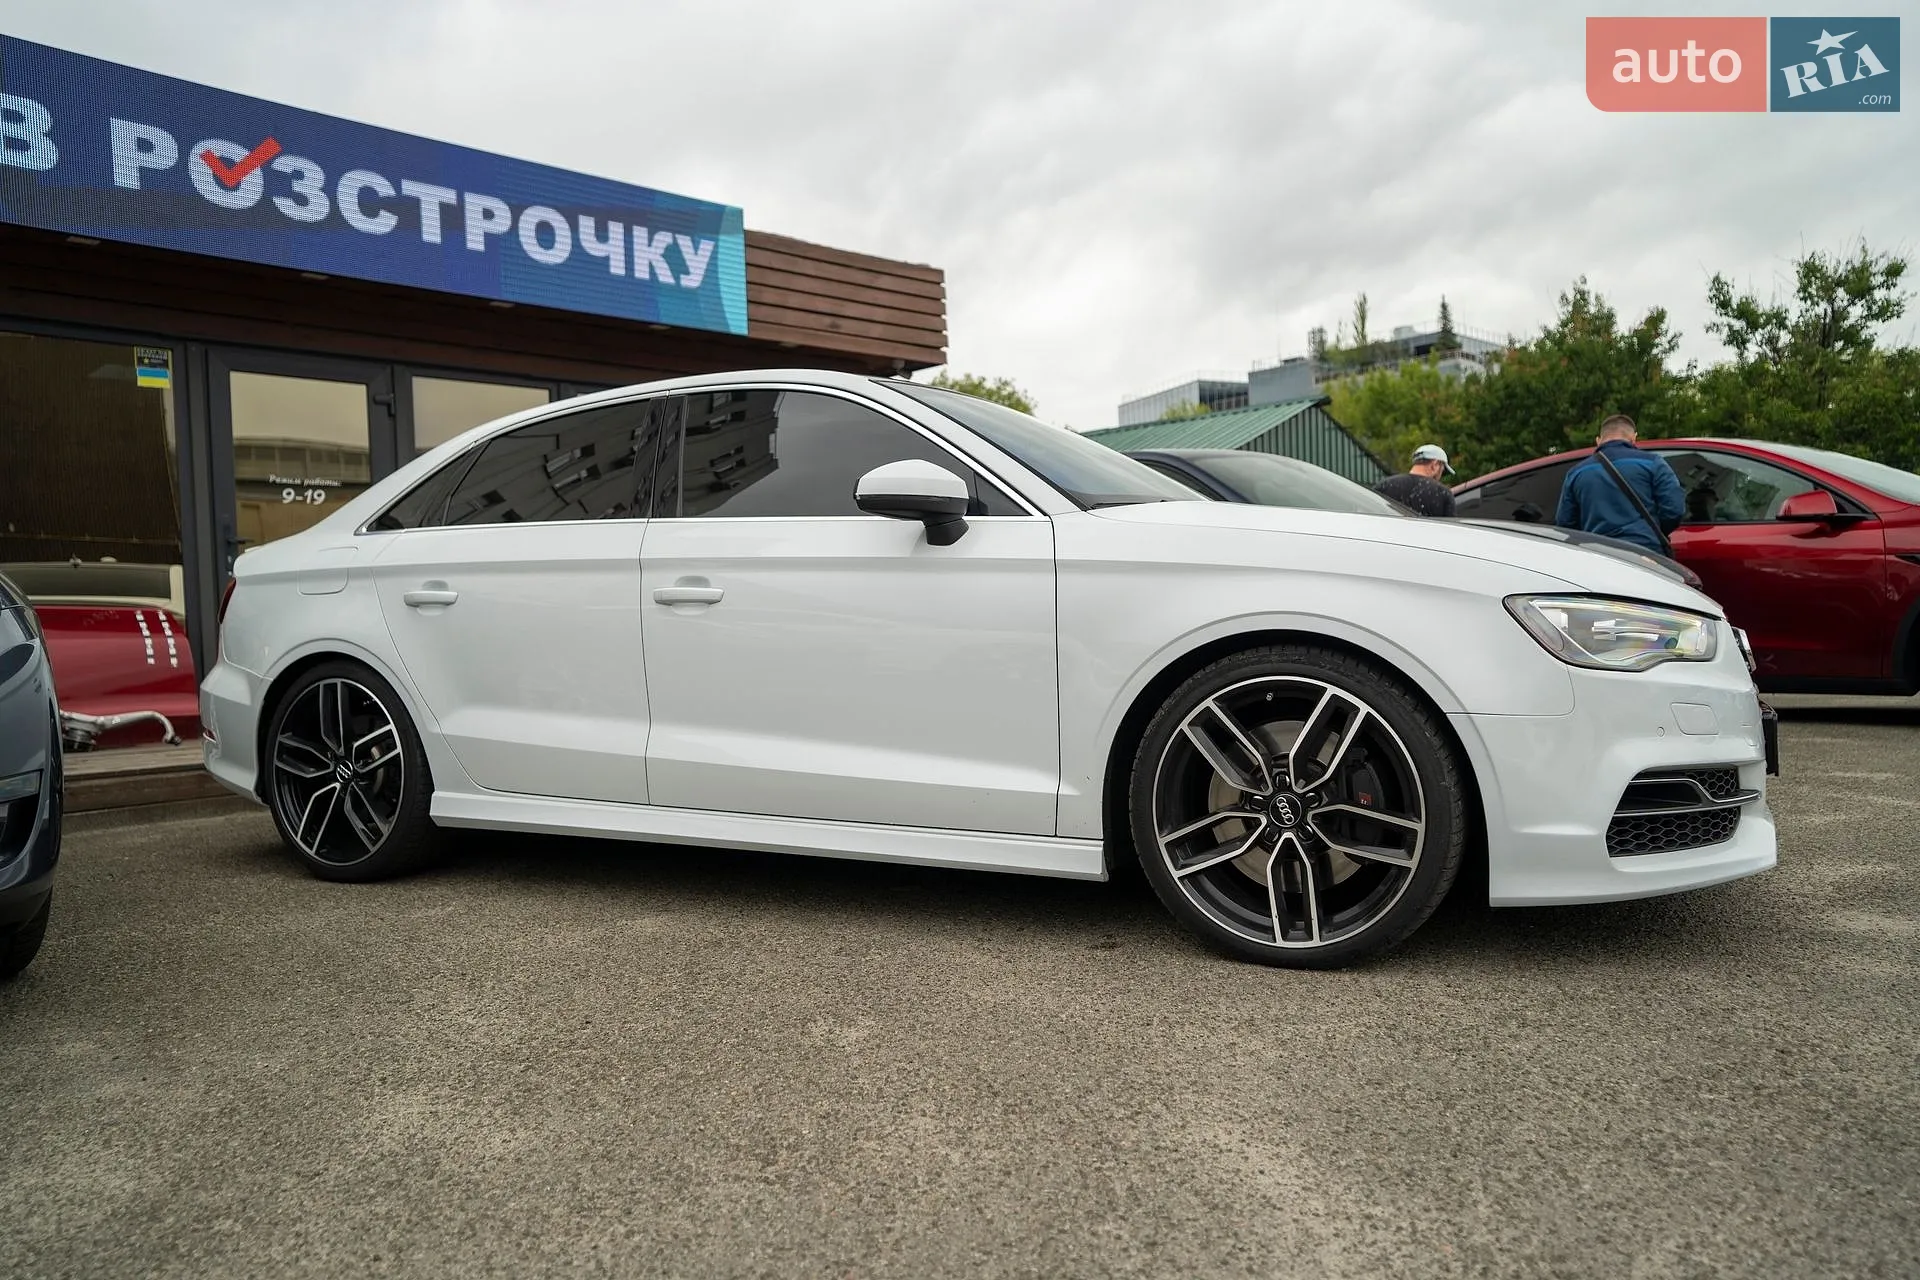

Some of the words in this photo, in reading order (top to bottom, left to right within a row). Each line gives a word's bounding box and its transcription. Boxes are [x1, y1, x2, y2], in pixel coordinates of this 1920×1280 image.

[0, 93, 59, 171] В
[110, 117, 716, 288] РОЗСТРОЧКУ
[282, 487, 326, 505] 9-19
